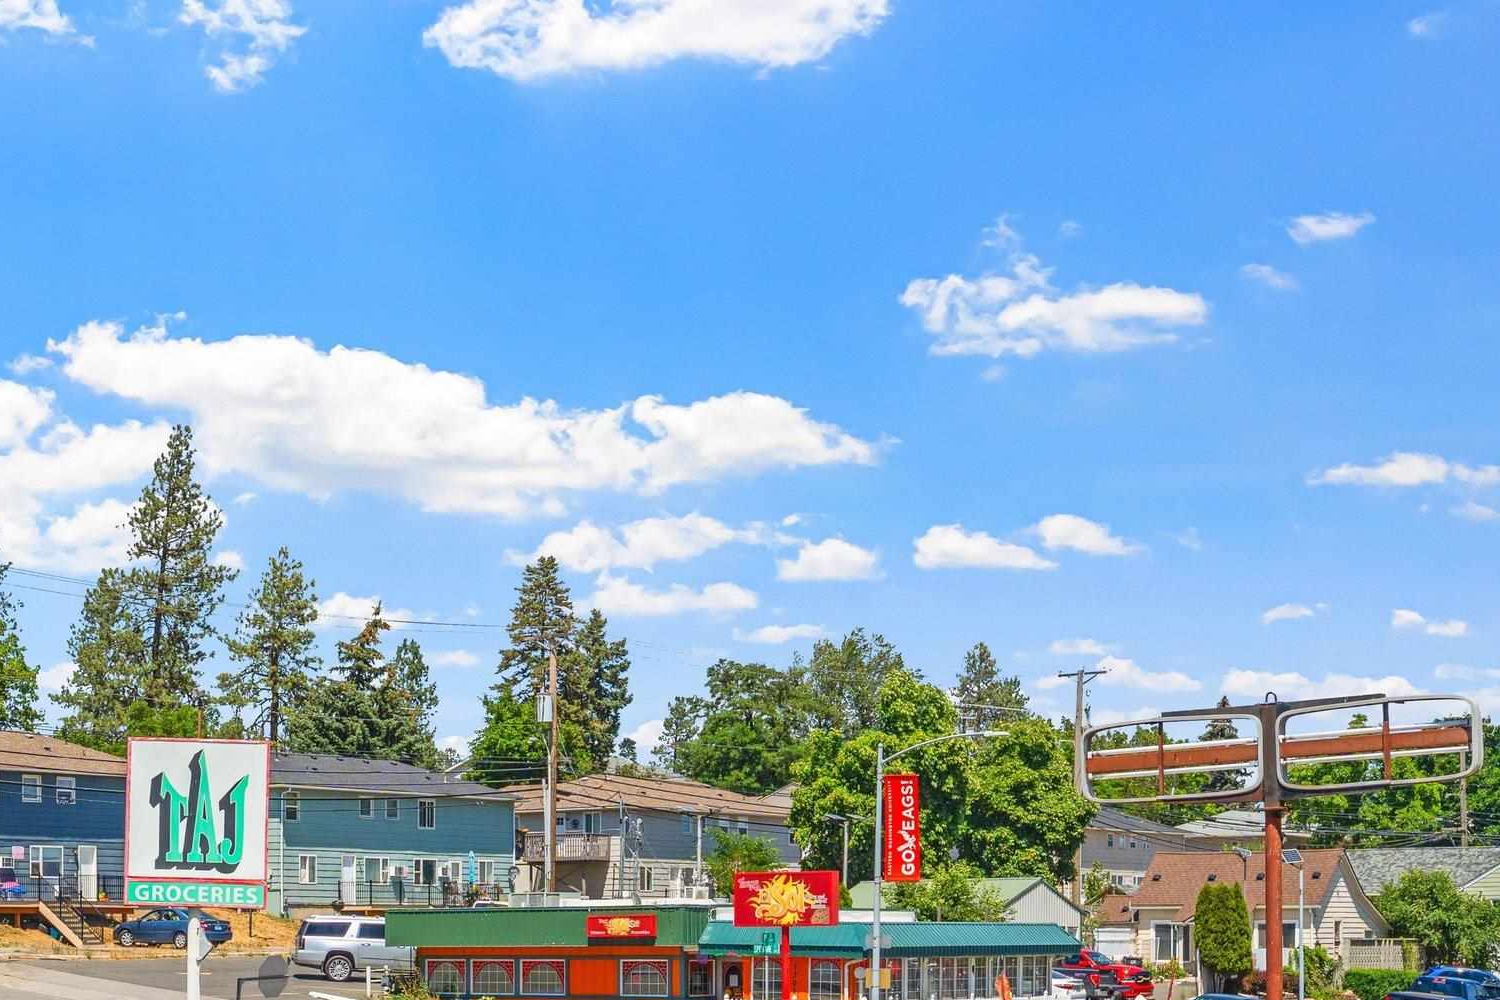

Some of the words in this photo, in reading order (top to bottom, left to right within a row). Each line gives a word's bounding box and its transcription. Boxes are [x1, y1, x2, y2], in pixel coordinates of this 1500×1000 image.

[150, 749, 249, 870] TAJ
[900, 780, 915, 831] EAGS!
[901, 850, 915, 876] GO
[134, 884, 258, 903] GROCERIES
